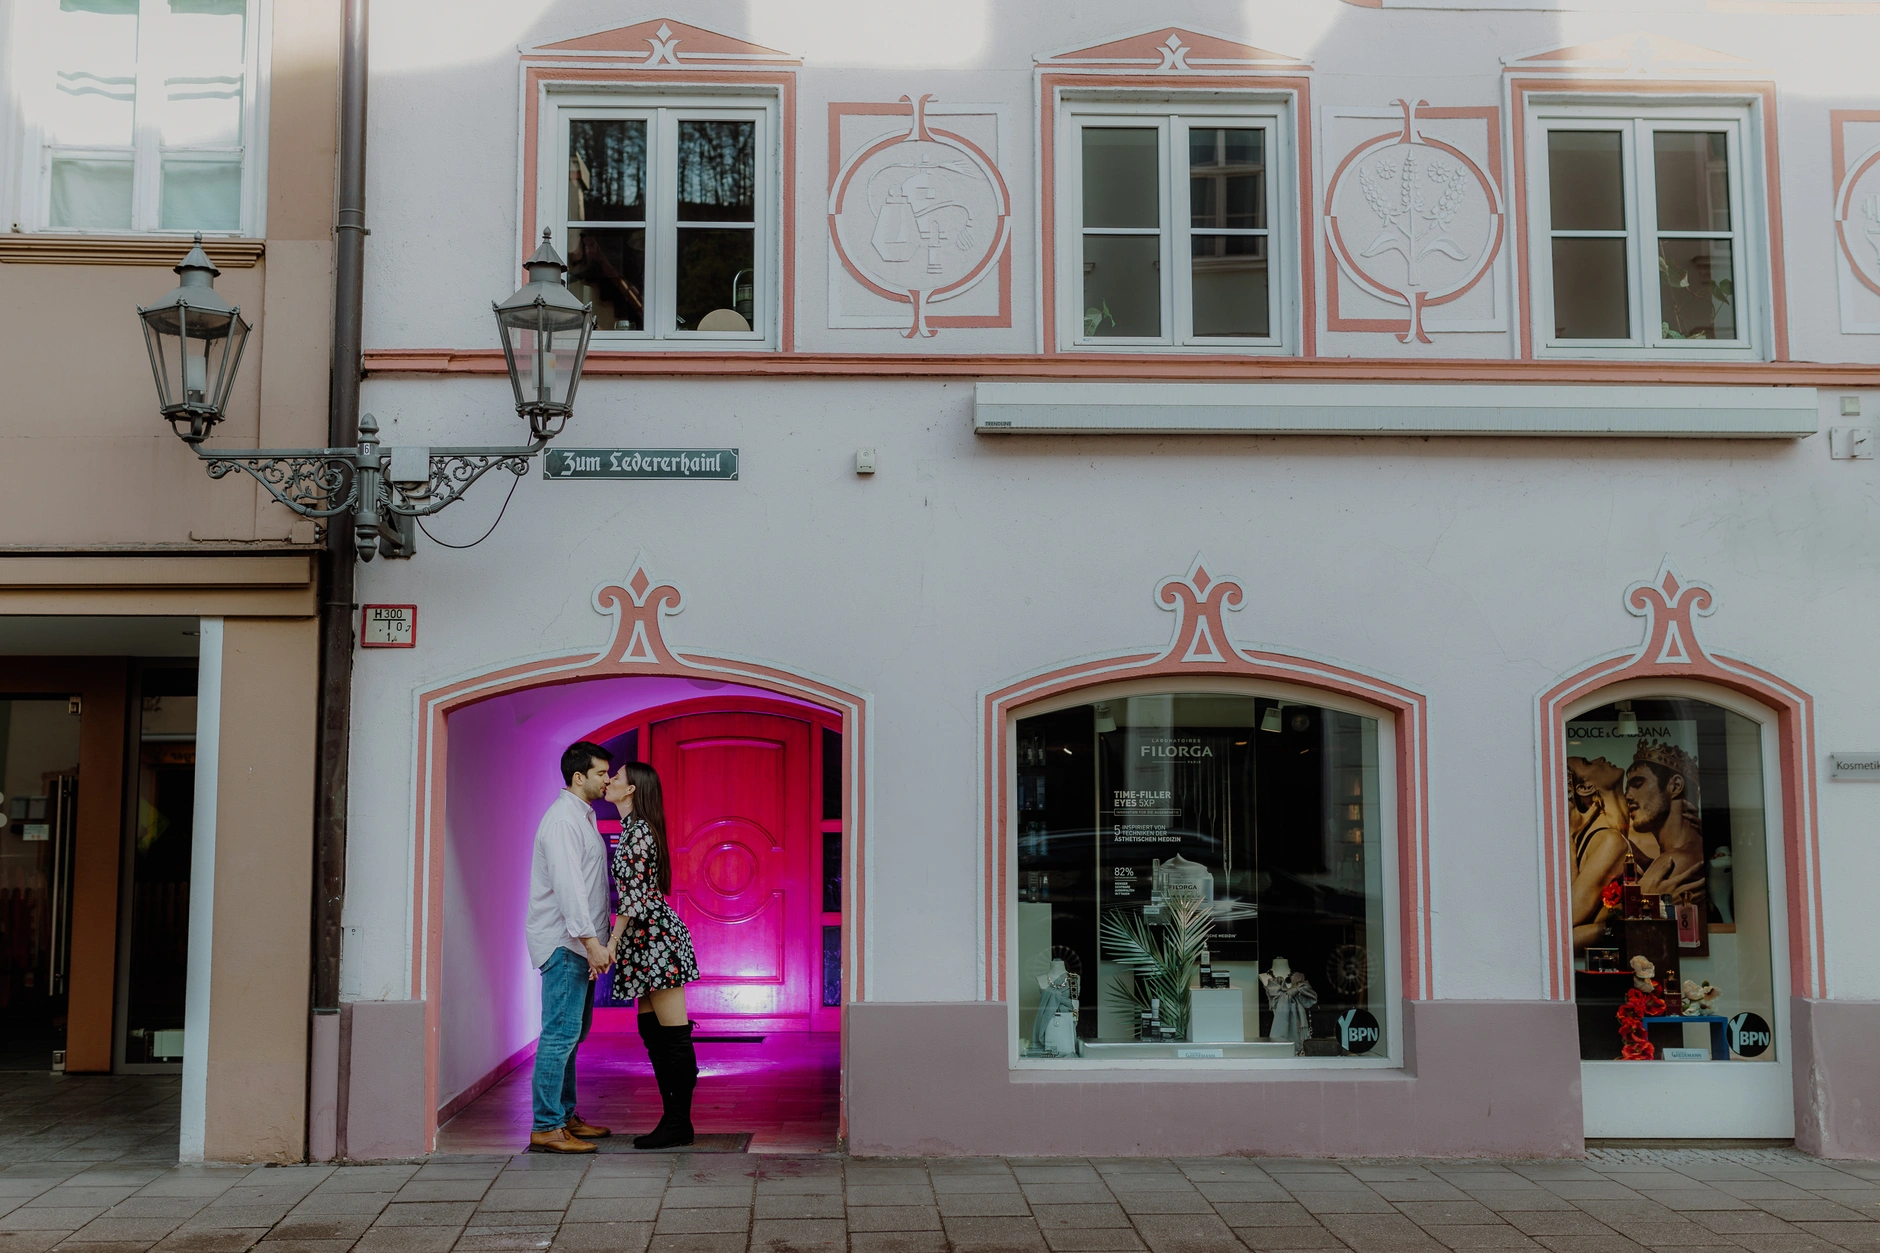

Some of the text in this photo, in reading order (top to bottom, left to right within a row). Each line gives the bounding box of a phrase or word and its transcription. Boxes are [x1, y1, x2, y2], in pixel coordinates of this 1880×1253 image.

[364, 444, 370, 454] 6
[560, 452, 722, 476] Zum Ledererhainl
[1567, 727, 1604, 739] DOLCE
[1140, 745, 1213, 757] FILORGA
[1114, 791, 1171, 799] TIME-FILLER
[1114, 799, 1155, 807] EYES 5XP
[1114, 825, 1121, 836] 5
[1114, 867, 1135, 877] 82%
